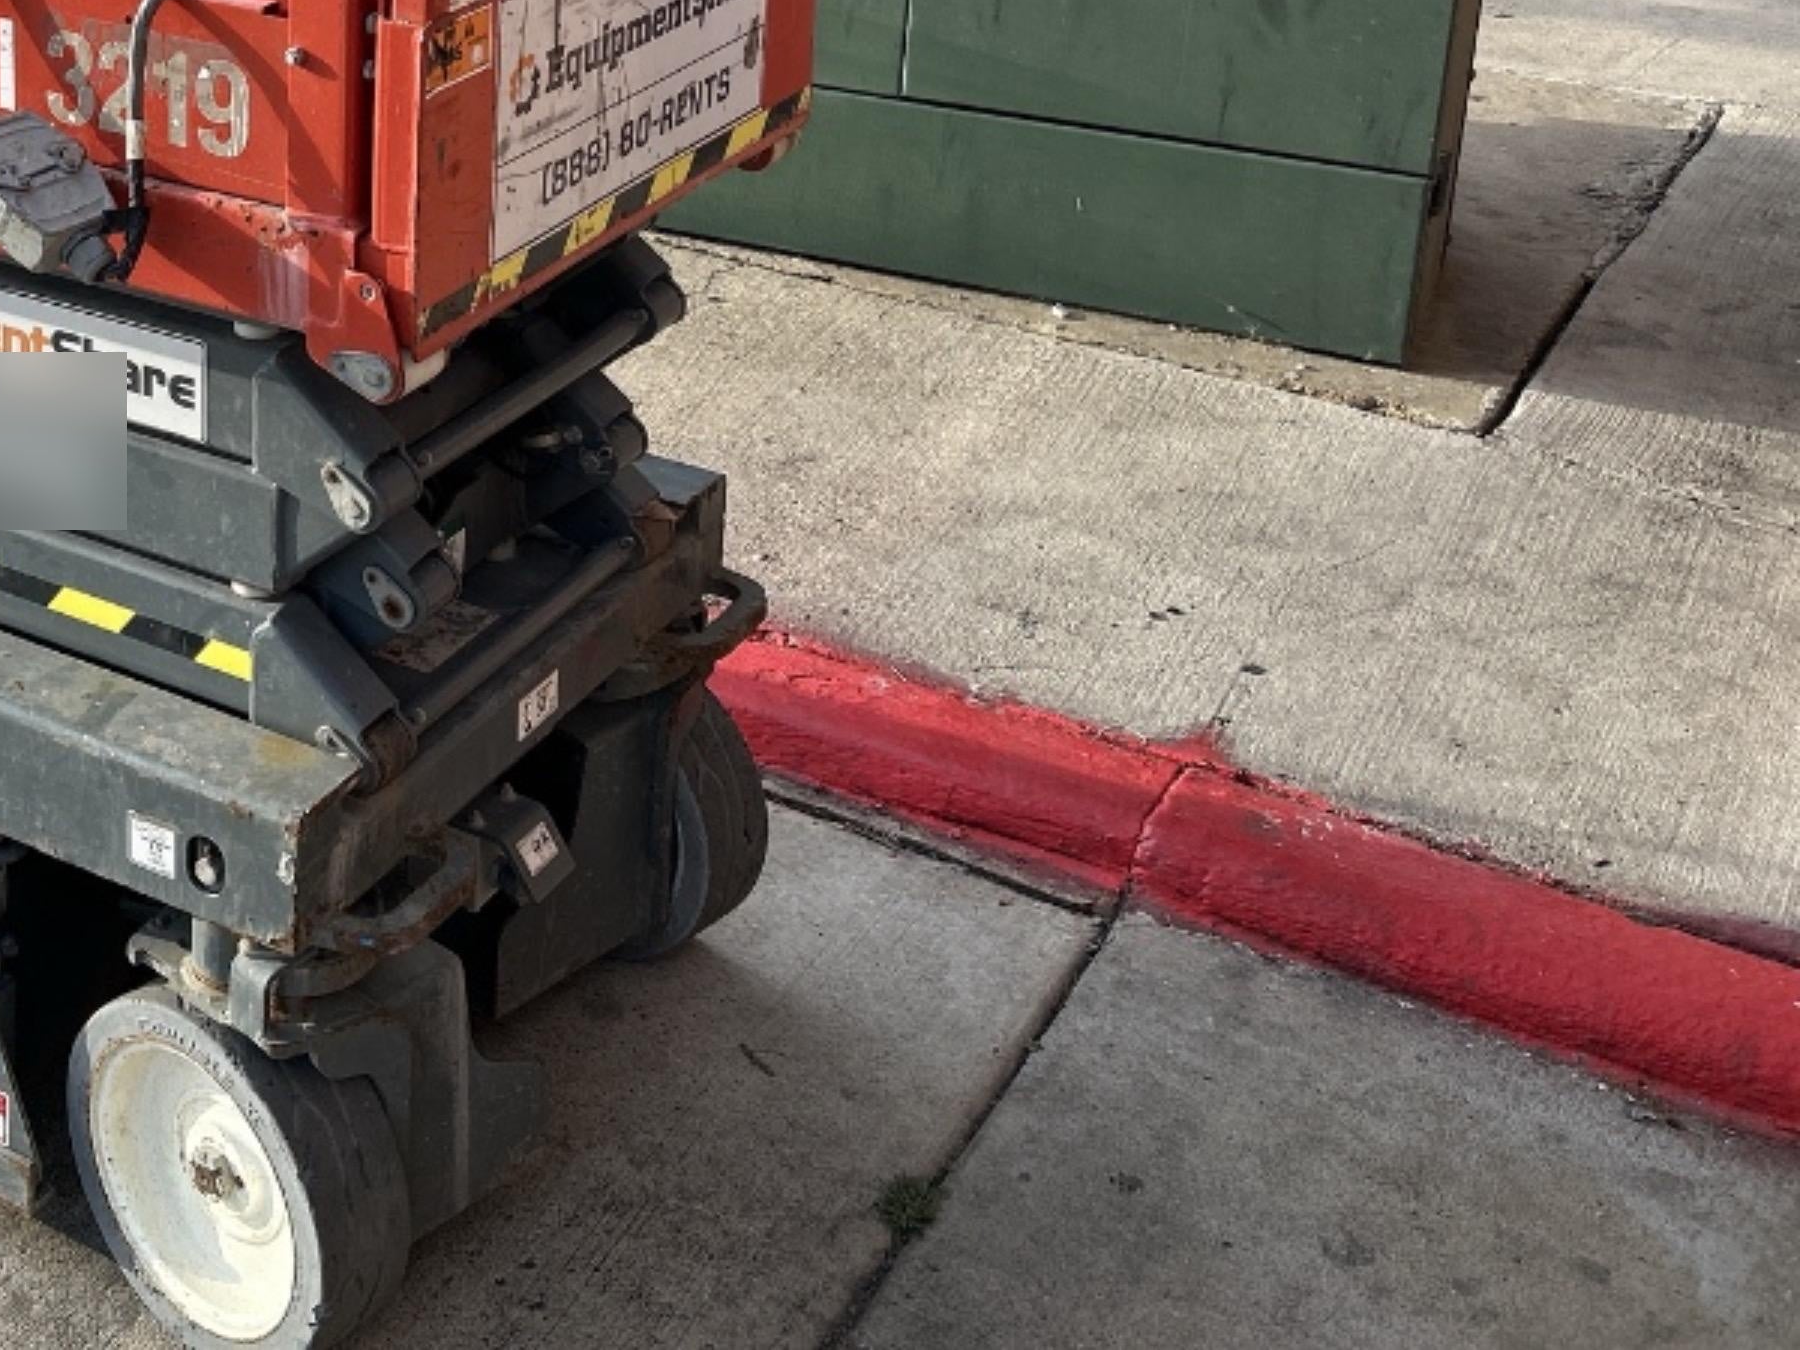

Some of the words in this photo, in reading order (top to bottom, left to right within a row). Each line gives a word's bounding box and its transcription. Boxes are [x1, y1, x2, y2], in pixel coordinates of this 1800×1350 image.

[45, 29, 252, 159] 3219
[541, 132, 611, 206] (888)
[619, 66, 731, 157] 80-RENTS
